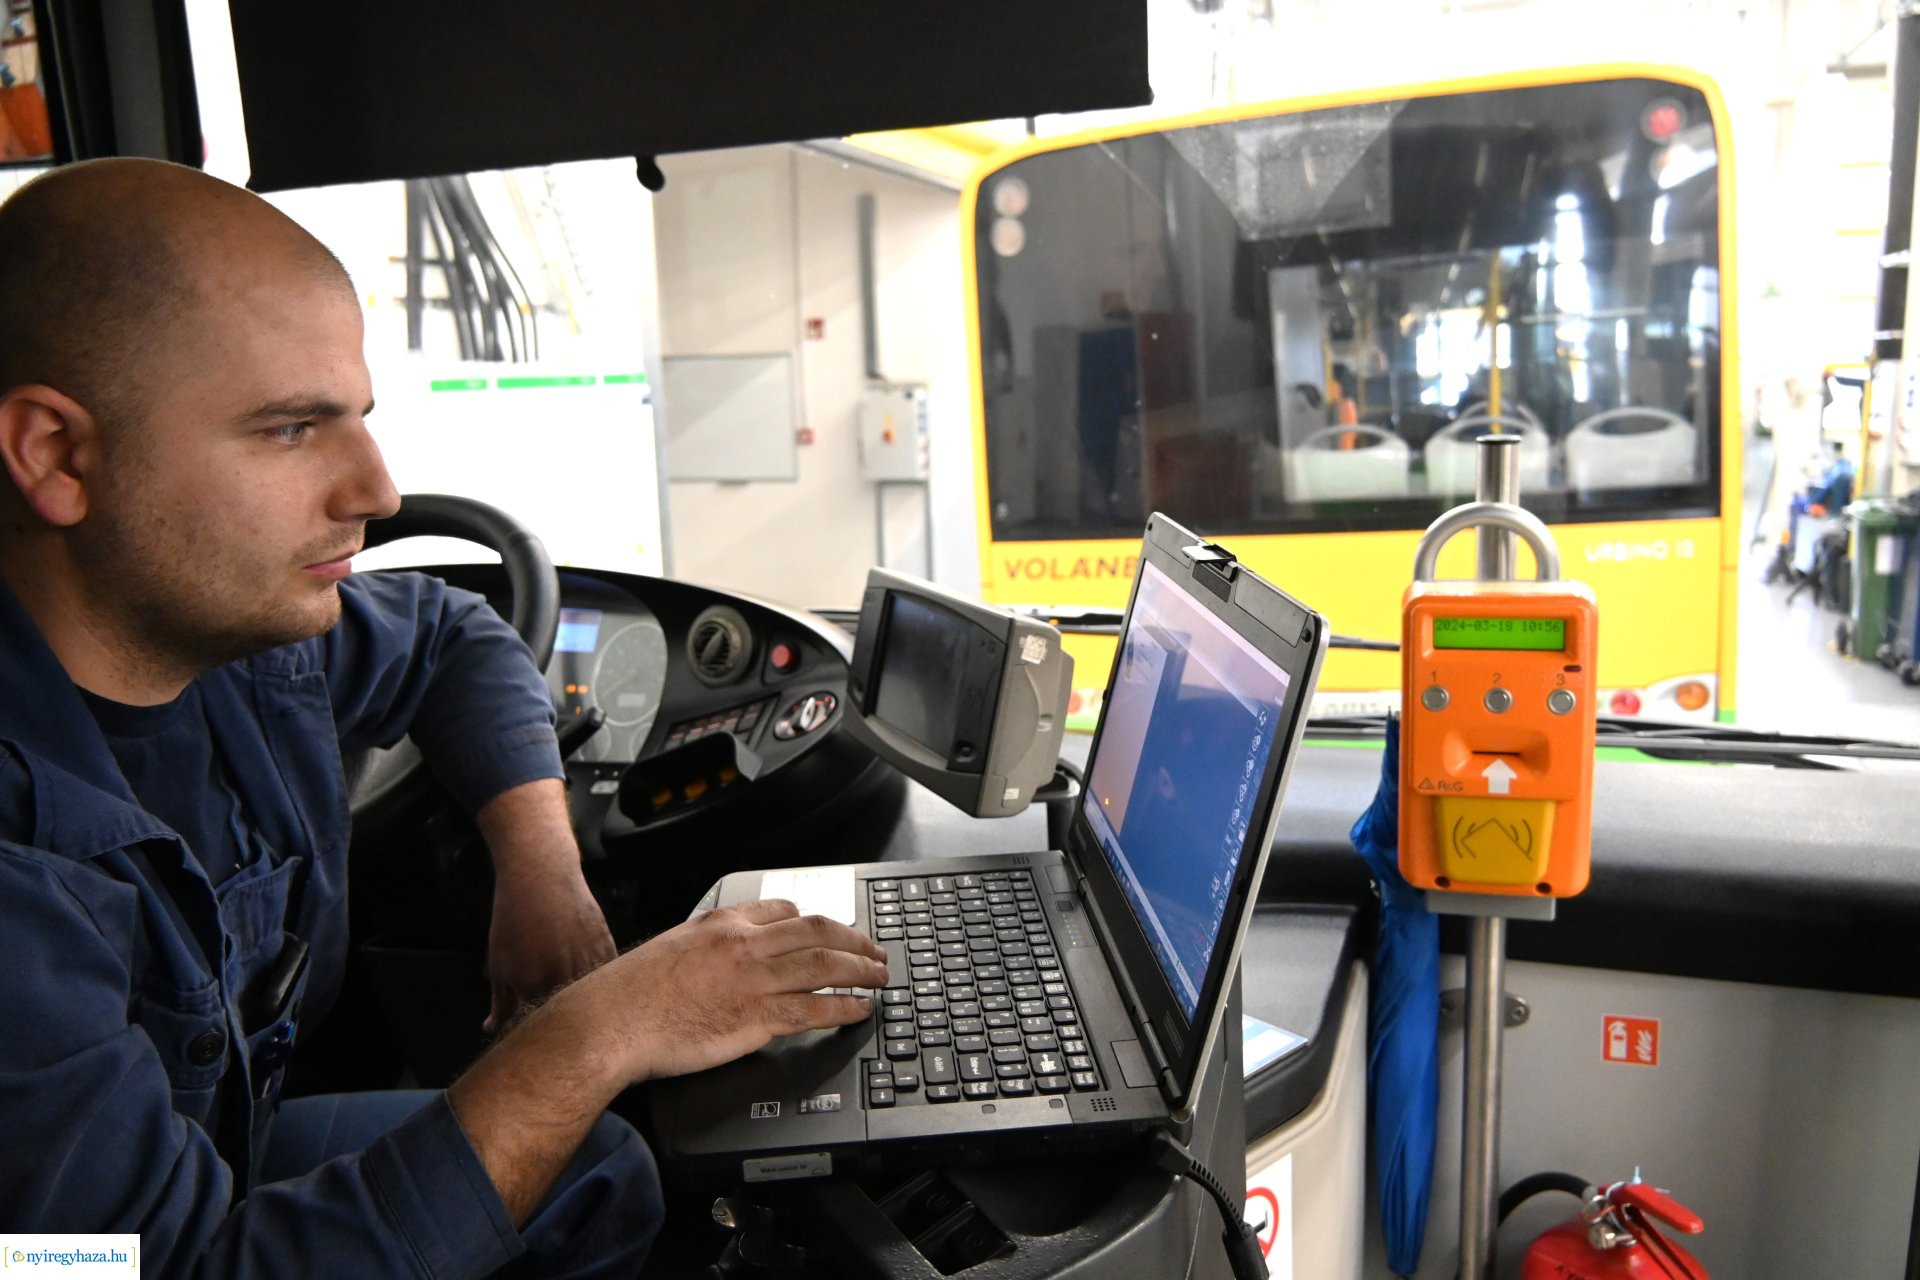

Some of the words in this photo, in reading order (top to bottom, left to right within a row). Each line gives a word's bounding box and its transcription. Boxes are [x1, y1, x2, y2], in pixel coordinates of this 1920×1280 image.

[1522, 620, 1561, 633] 10:56
[1430, 671, 1437, 682] 1
[1492, 673, 1501, 684] 2
[1556, 673, 1565, 686] 3
